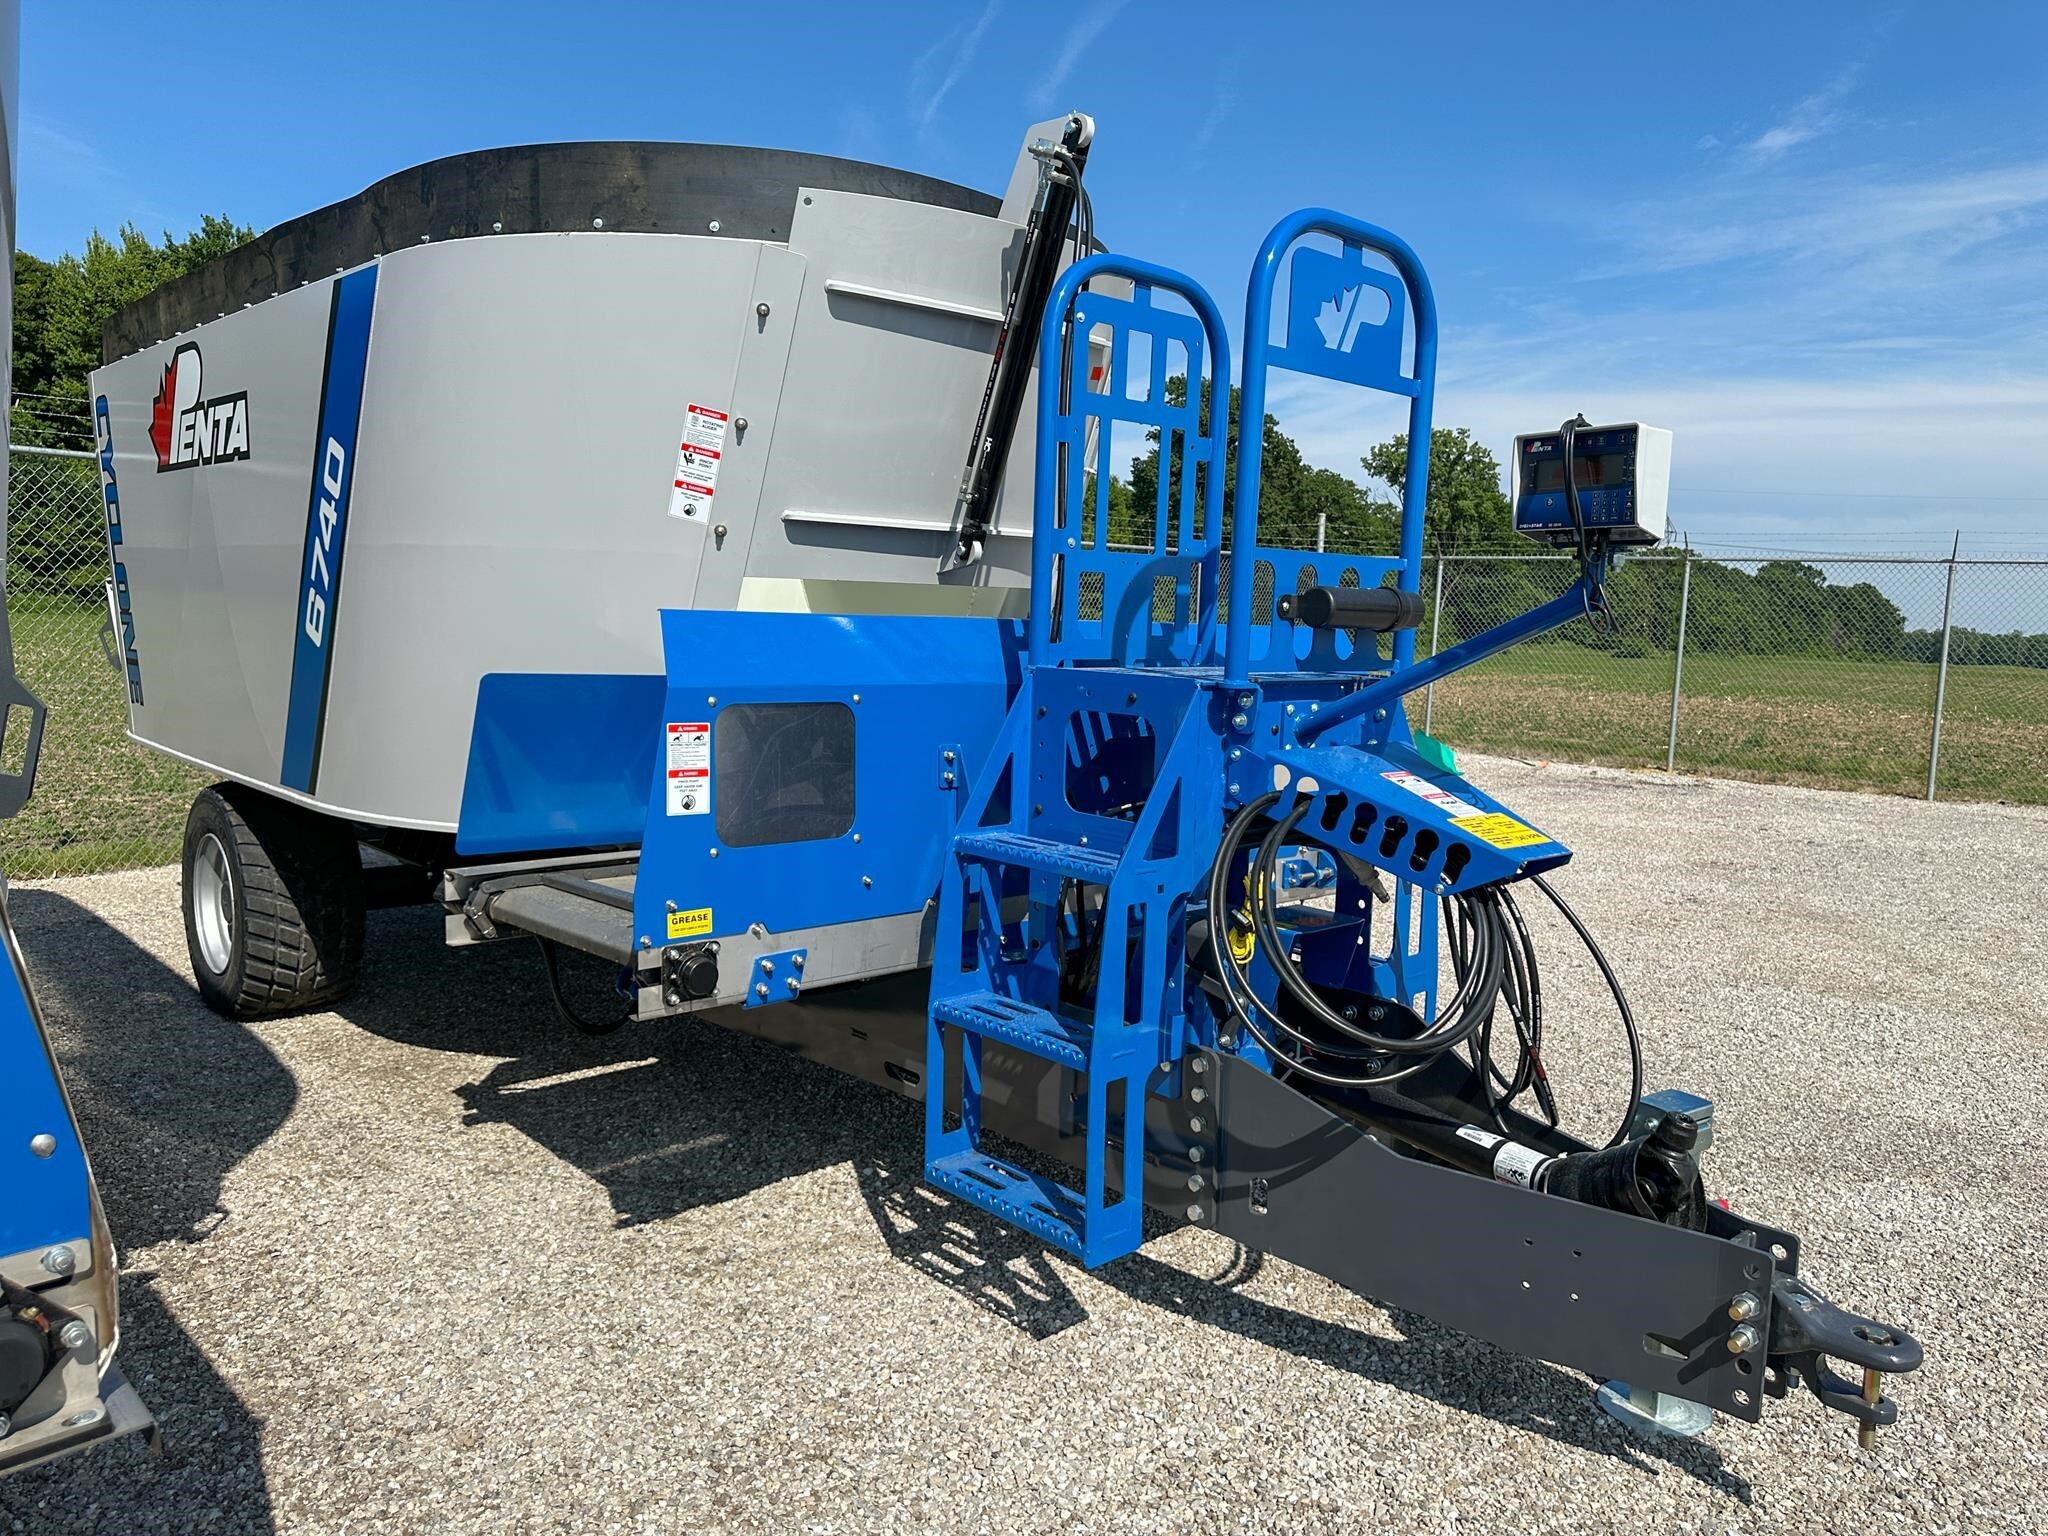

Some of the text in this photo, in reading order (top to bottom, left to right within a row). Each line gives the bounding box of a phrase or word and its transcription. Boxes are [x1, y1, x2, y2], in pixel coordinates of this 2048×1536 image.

[167, 344, 249, 467] PENTA
[1530, 441, 1553, 453] PENTA
[305, 436, 345, 648] 6740
[671, 913, 709, 926] GREASE
